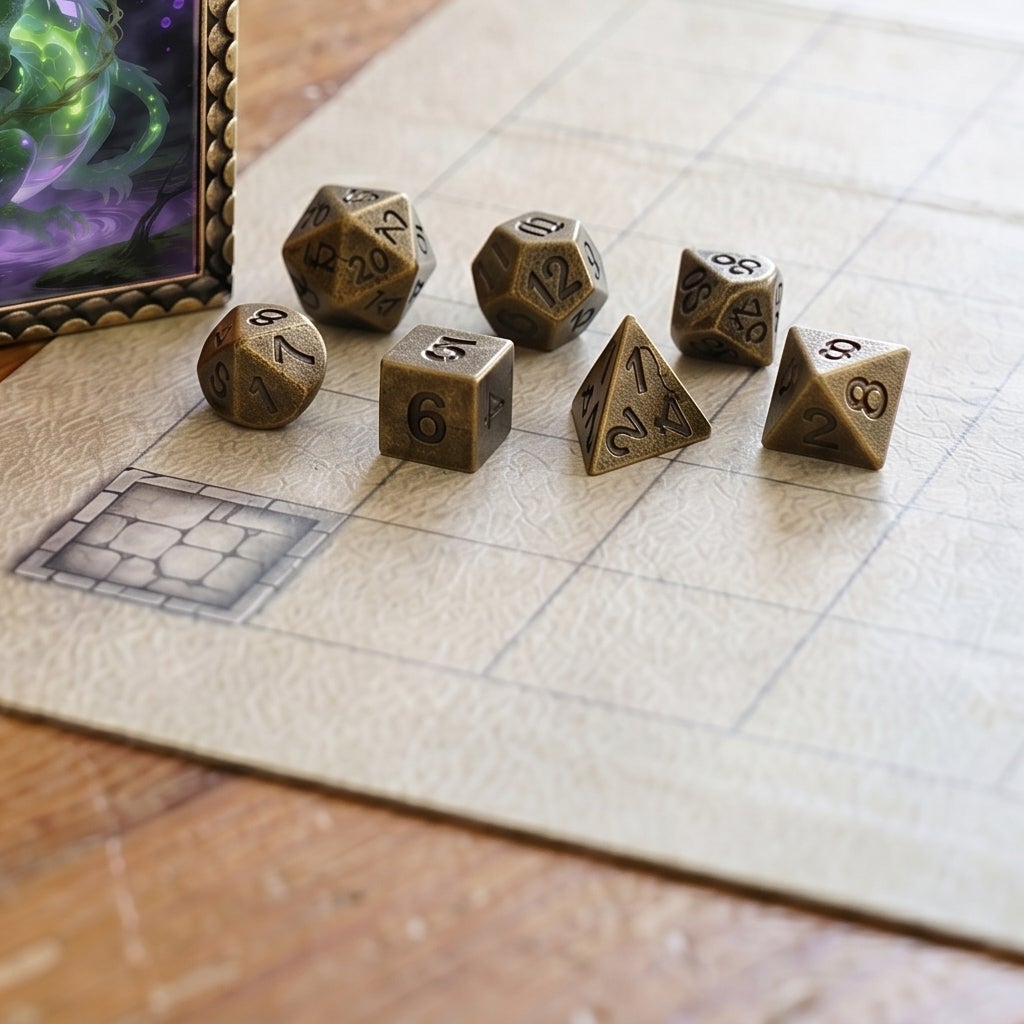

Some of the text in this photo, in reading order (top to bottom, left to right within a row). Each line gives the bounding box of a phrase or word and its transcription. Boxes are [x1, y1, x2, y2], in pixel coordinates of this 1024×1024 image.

[348, 247, 390, 285] 20
[527, 255, 584, 308] 12
[273, 334, 316, 366] 7
[626, 346, 648, 394] 1
[406, 390, 447, 445] 6
[844, 376, 889, 421] 8
[605, 406, 648, 458] 2
[802, 407, 840, 451] 2
